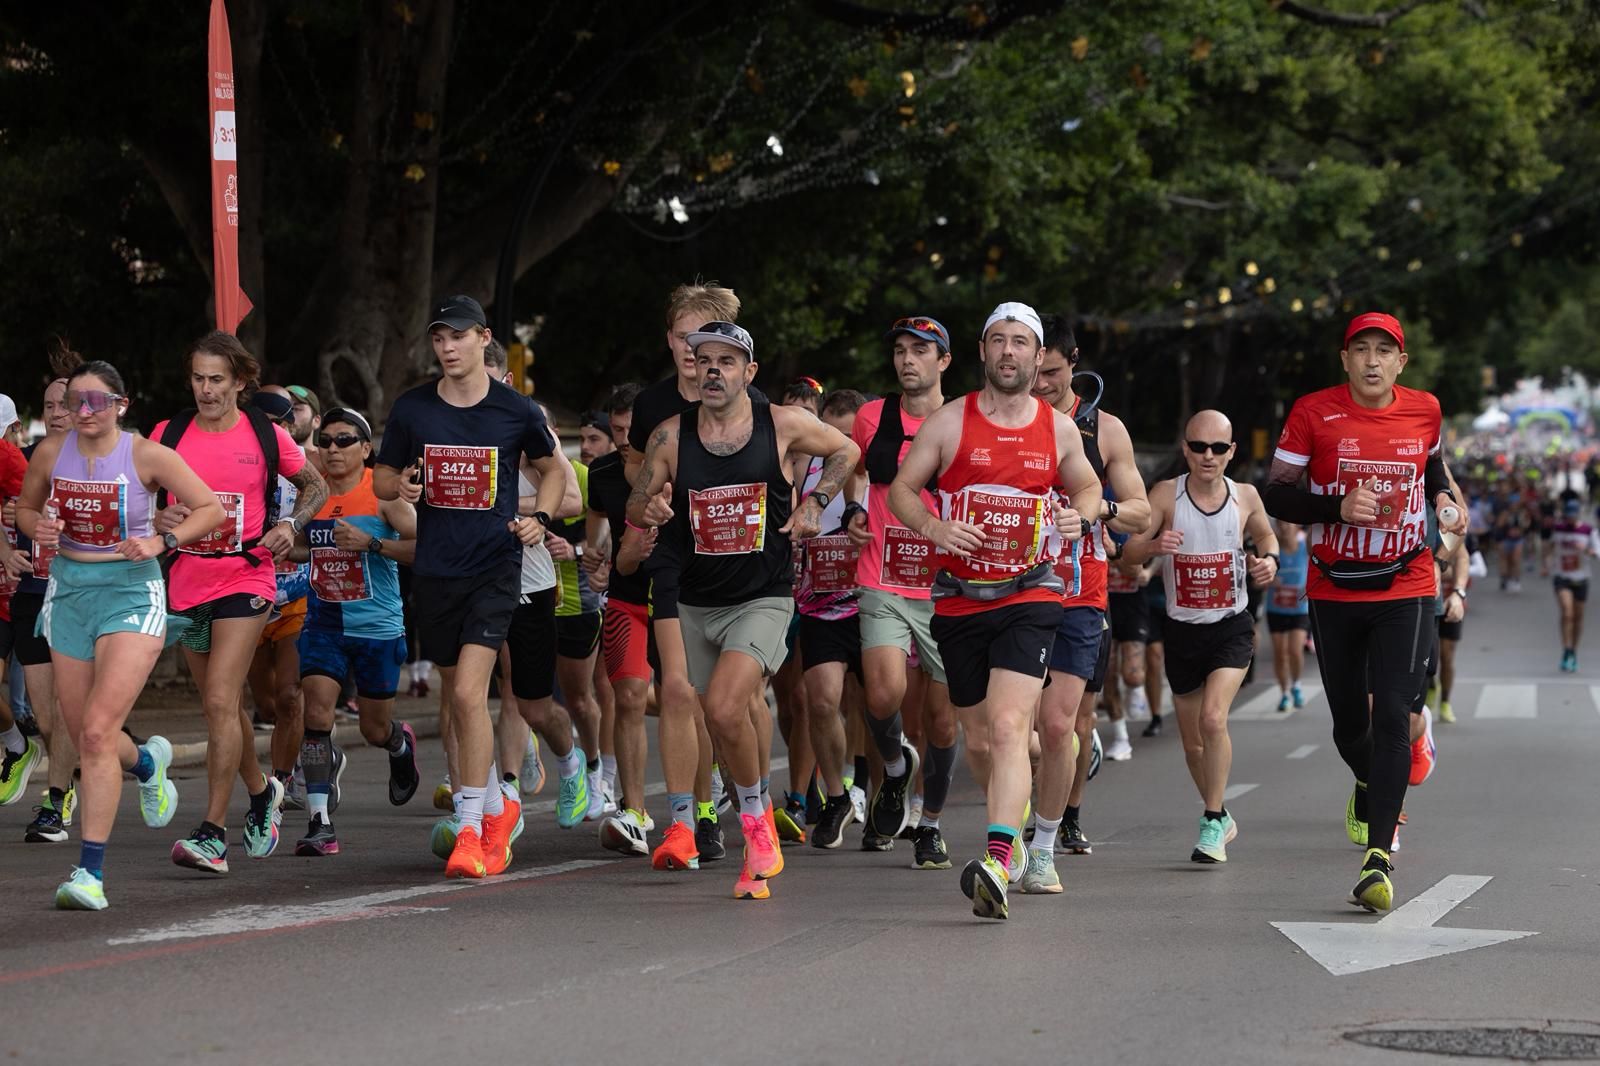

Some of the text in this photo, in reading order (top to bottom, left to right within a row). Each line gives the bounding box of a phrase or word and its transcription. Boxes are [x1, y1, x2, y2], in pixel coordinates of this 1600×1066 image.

[443, 448, 486, 458] GENERALI
[441, 462, 475, 474] 3474
[1358, 463, 1406, 475] GENERALI
[67, 483, 114, 494] GENERALI
[1356, 478, 1393, 493] 166
[707, 486, 755, 500] GENERALI
[65, 498, 102, 512] 4525
[987, 495, 1034, 508] GENERALI
[707, 502, 744, 518] 3234
[983, 510, 1021, 528] 2688
[897, 542, 929, 557] 2523
[816, 550, 845, 562] 2195
[1186, 553, 1226, 564] GENERALI
[322, 561, 350, 572] 4226
[1186, 567, 1217, 579] 1485
[1039, 647, 1047, 664] FILA
